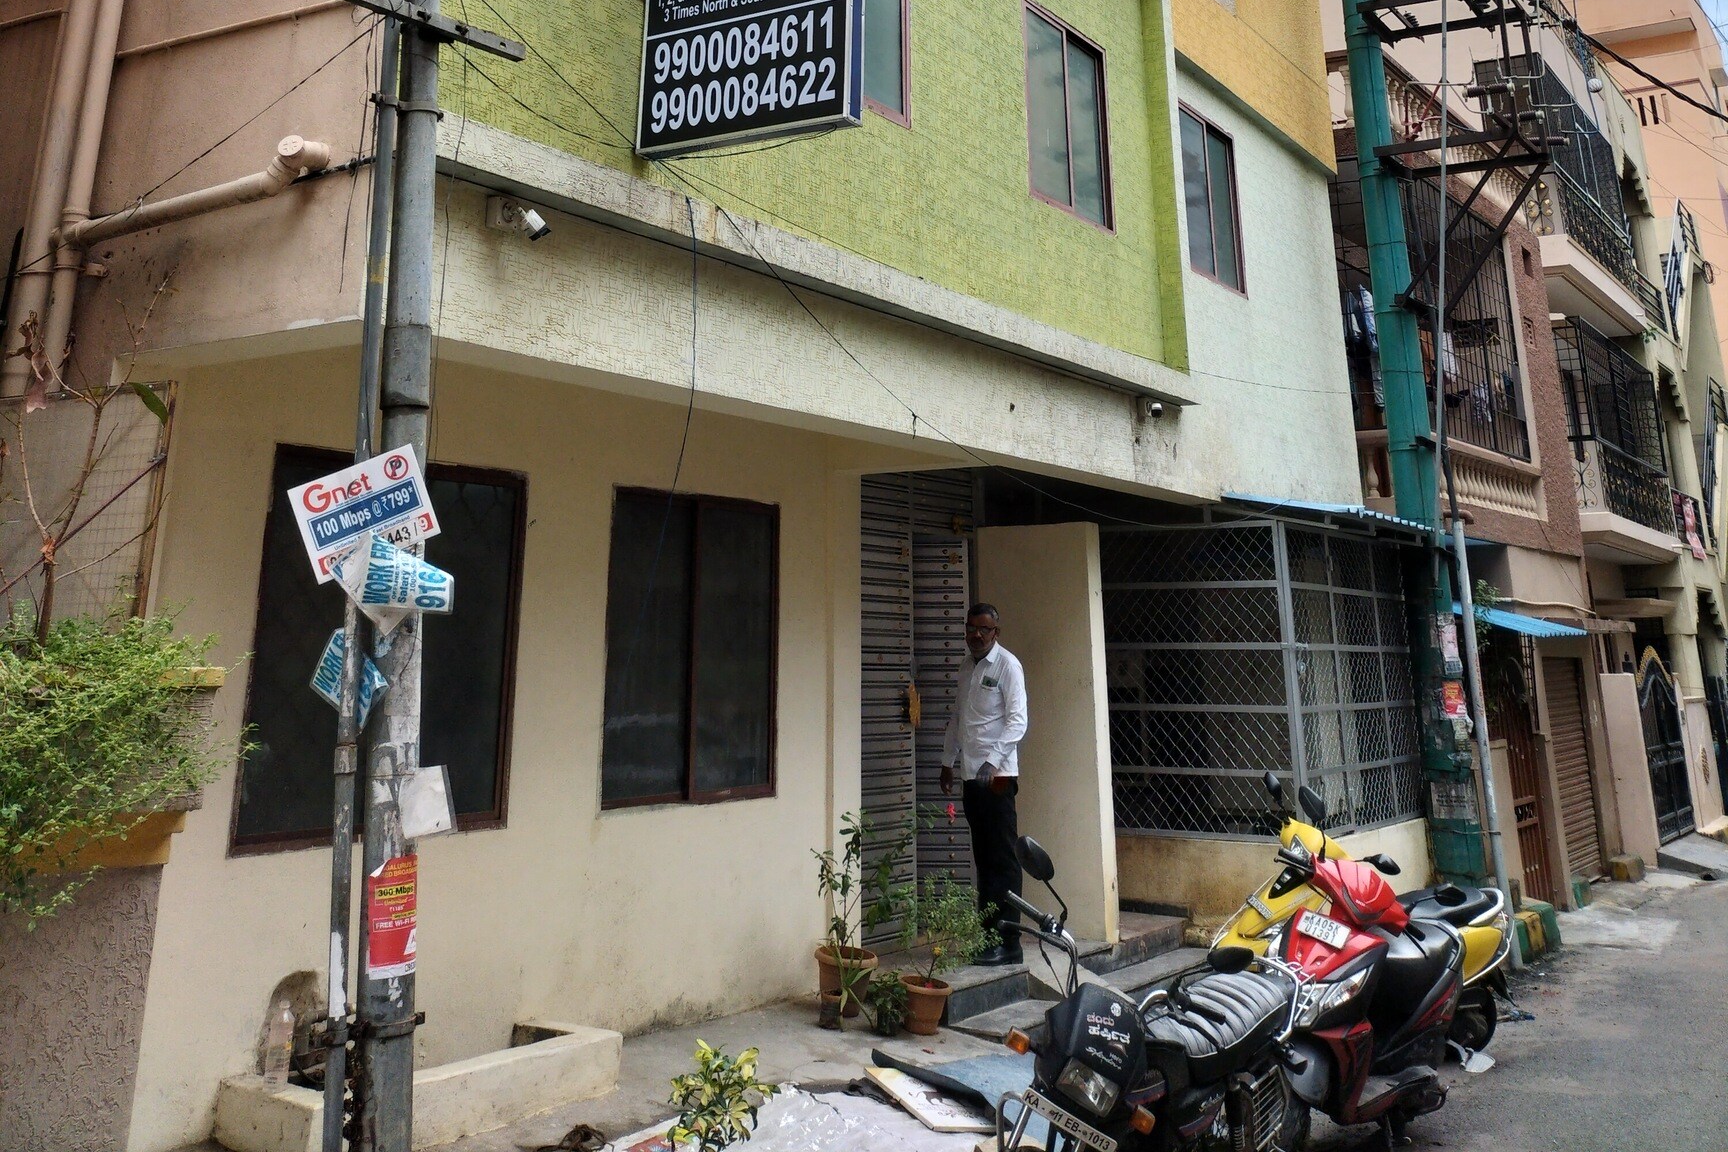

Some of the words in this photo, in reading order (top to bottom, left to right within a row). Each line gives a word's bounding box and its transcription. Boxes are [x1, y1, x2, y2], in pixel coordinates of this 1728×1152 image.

[663, 9, 670, 22] 3
[672, 4, 700, 21] Times
[653, 6, 834, 84] 9900084611
[650, 56, 836, 134] 9900084622
[302, 473, 372, 513] Gnet
[316, 516, 339, 538] 100
[339, 507, 372, 530] Mbps
[362, 562, 394, 604] WORK
[397, 570, 411, 603] Salary
[313, 647, 344, 695] WORK
[378, 888, 394, 897] 300
[375, 920, 394, 929] FREE
[1024, 1091, 1040, 1109] KA
[1087, 1131, 1111, 1151] 1013
